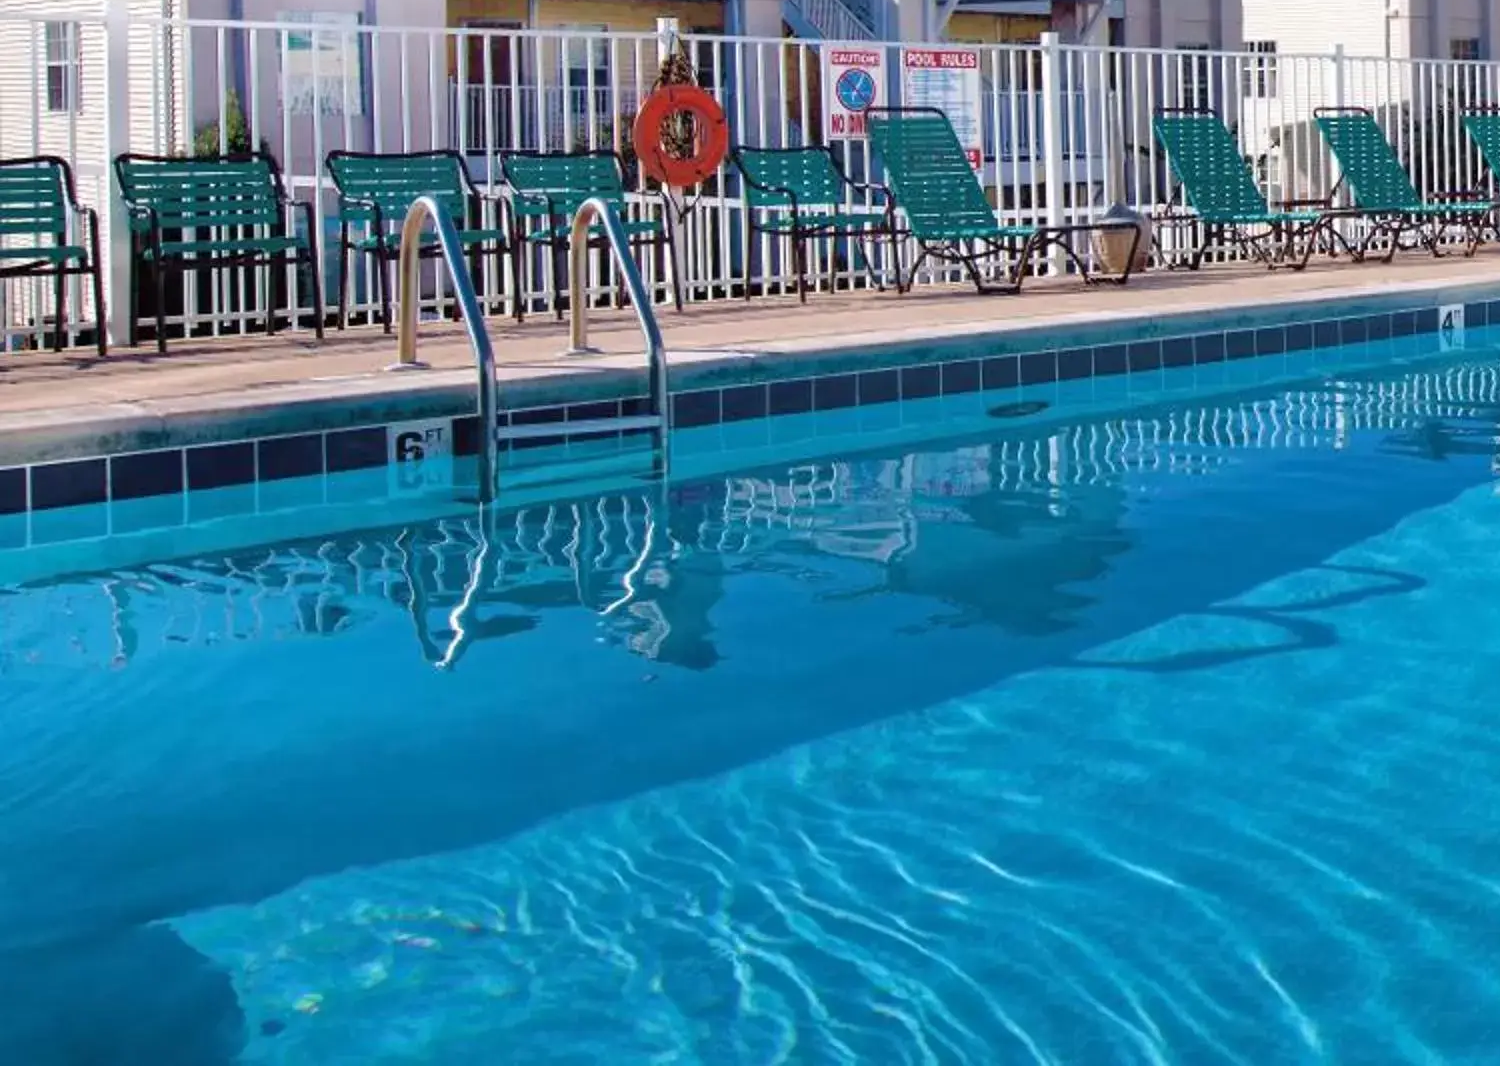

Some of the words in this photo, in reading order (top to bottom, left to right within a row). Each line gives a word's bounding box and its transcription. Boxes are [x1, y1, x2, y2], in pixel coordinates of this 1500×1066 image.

[907, 53, 937, 66] POOL
[940, 54, 976, 67] RULES
[831, 113, 845, 134] NO
[1441, 310, 1455, 331] 4
[396, 431, 425, 465] 6
[425, 427, 444, 443] FT
